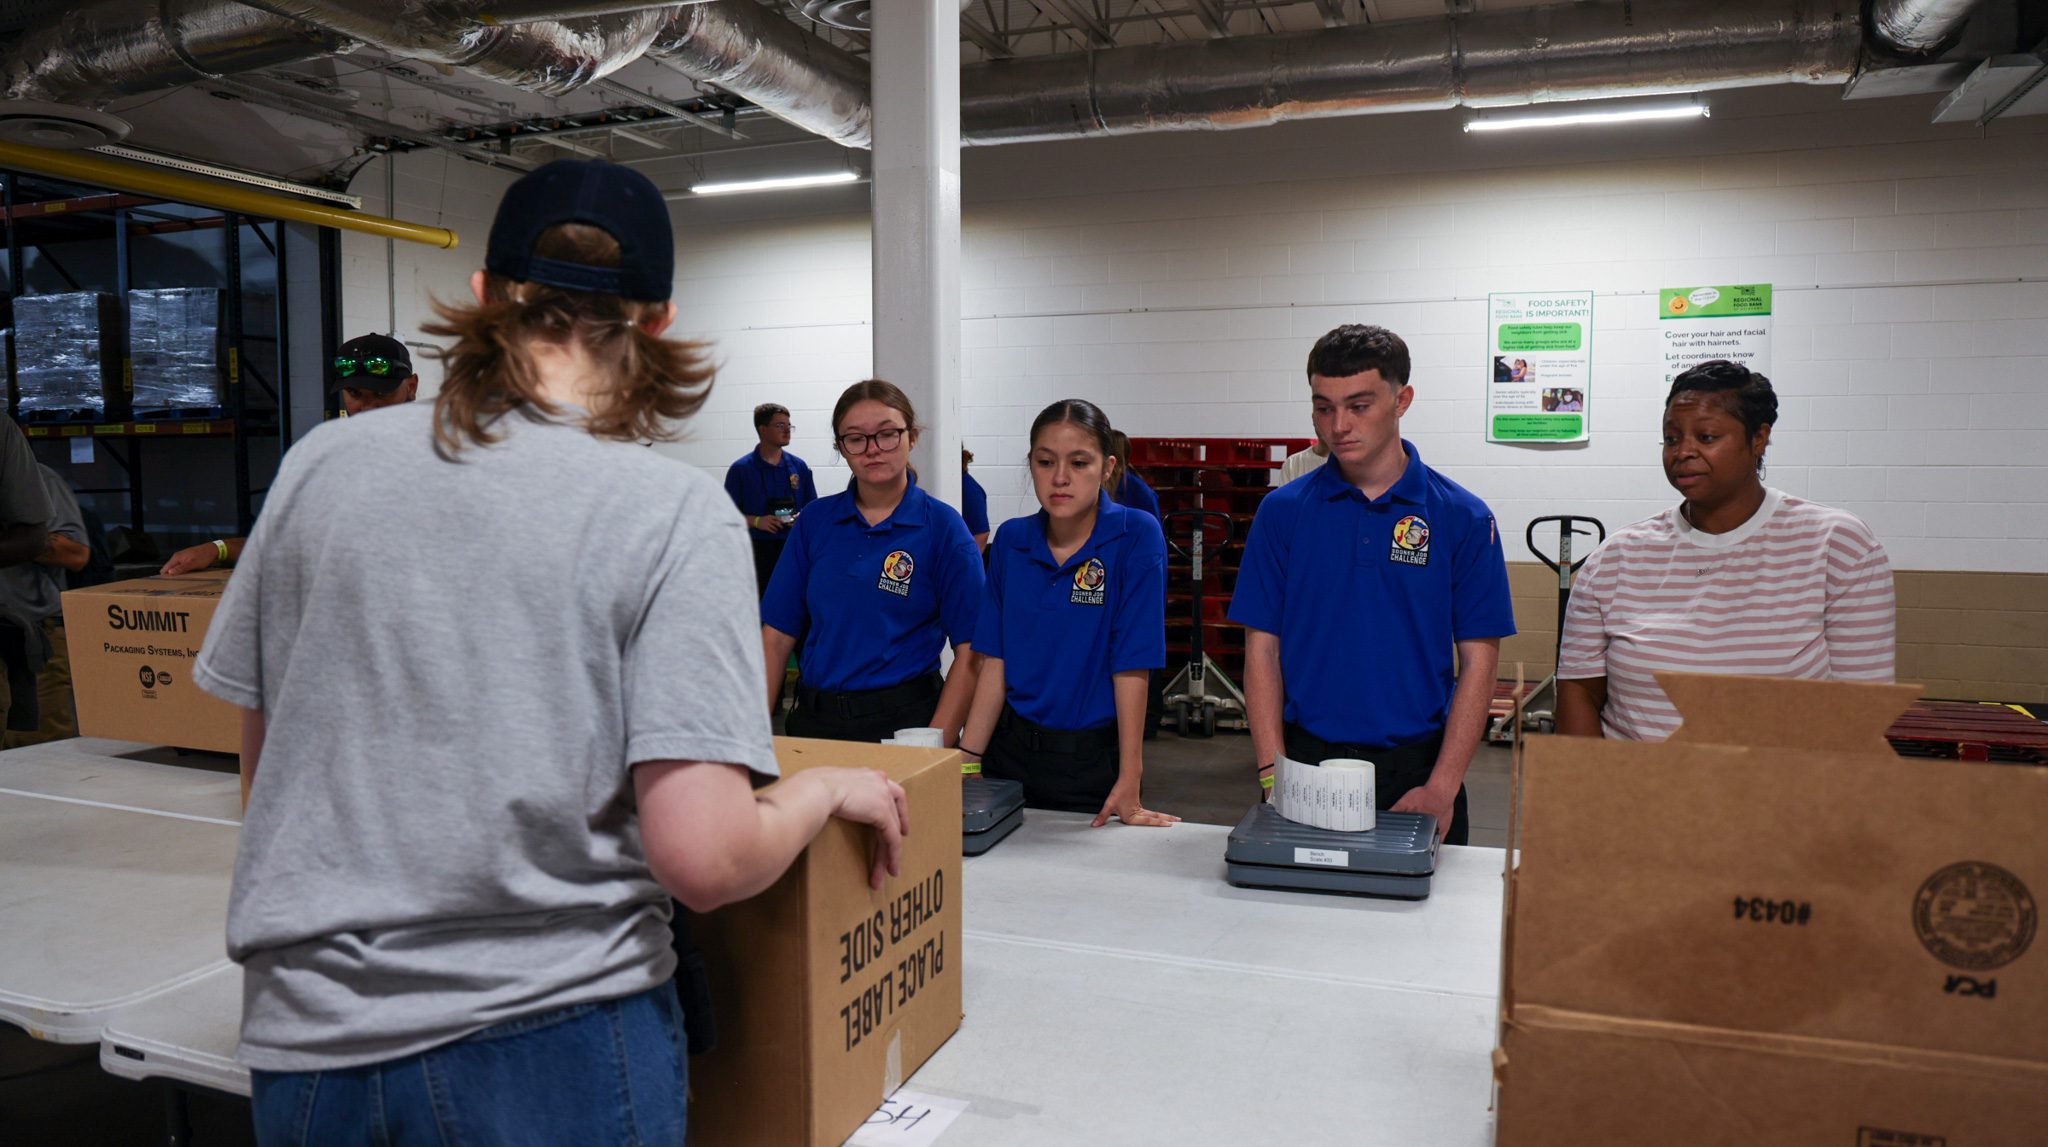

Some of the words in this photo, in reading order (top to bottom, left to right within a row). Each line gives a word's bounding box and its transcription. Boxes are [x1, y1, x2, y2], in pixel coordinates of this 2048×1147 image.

[1554, 299, 1588, 307] SAFETY
[1526, 310, 1534, 318] IS
[1535, 309, 1589, 317] IMPORTANT!
[1665, 331, 1689, 339] Cover
[1690, 331, 1709, 340] your
[1743, 328, 1766, 336] facial
[1681, 351, 1731, 360] coordinators
[1390, 553, 1427, 565] CHALLENGE
[878, 582, 909, 597] CHALLENGE
[1070, 595, 1104, 604] CHALLENGE
[107, 604, 190, 633] SUMMIT
[103, 642, 146, 655] PACKAGING
[147, 645, 186, 659] SYSTEMS,
[890, 868, 943, 945] OTHER
[1733, 895, 1812, 926] #0434
[839, 909, 884, 985] SIDE
[898, 930, 944, 1008] PLACE
[1943, 973, 1998, 999] PCA
[840, 970, 893, 1052] LABEL
